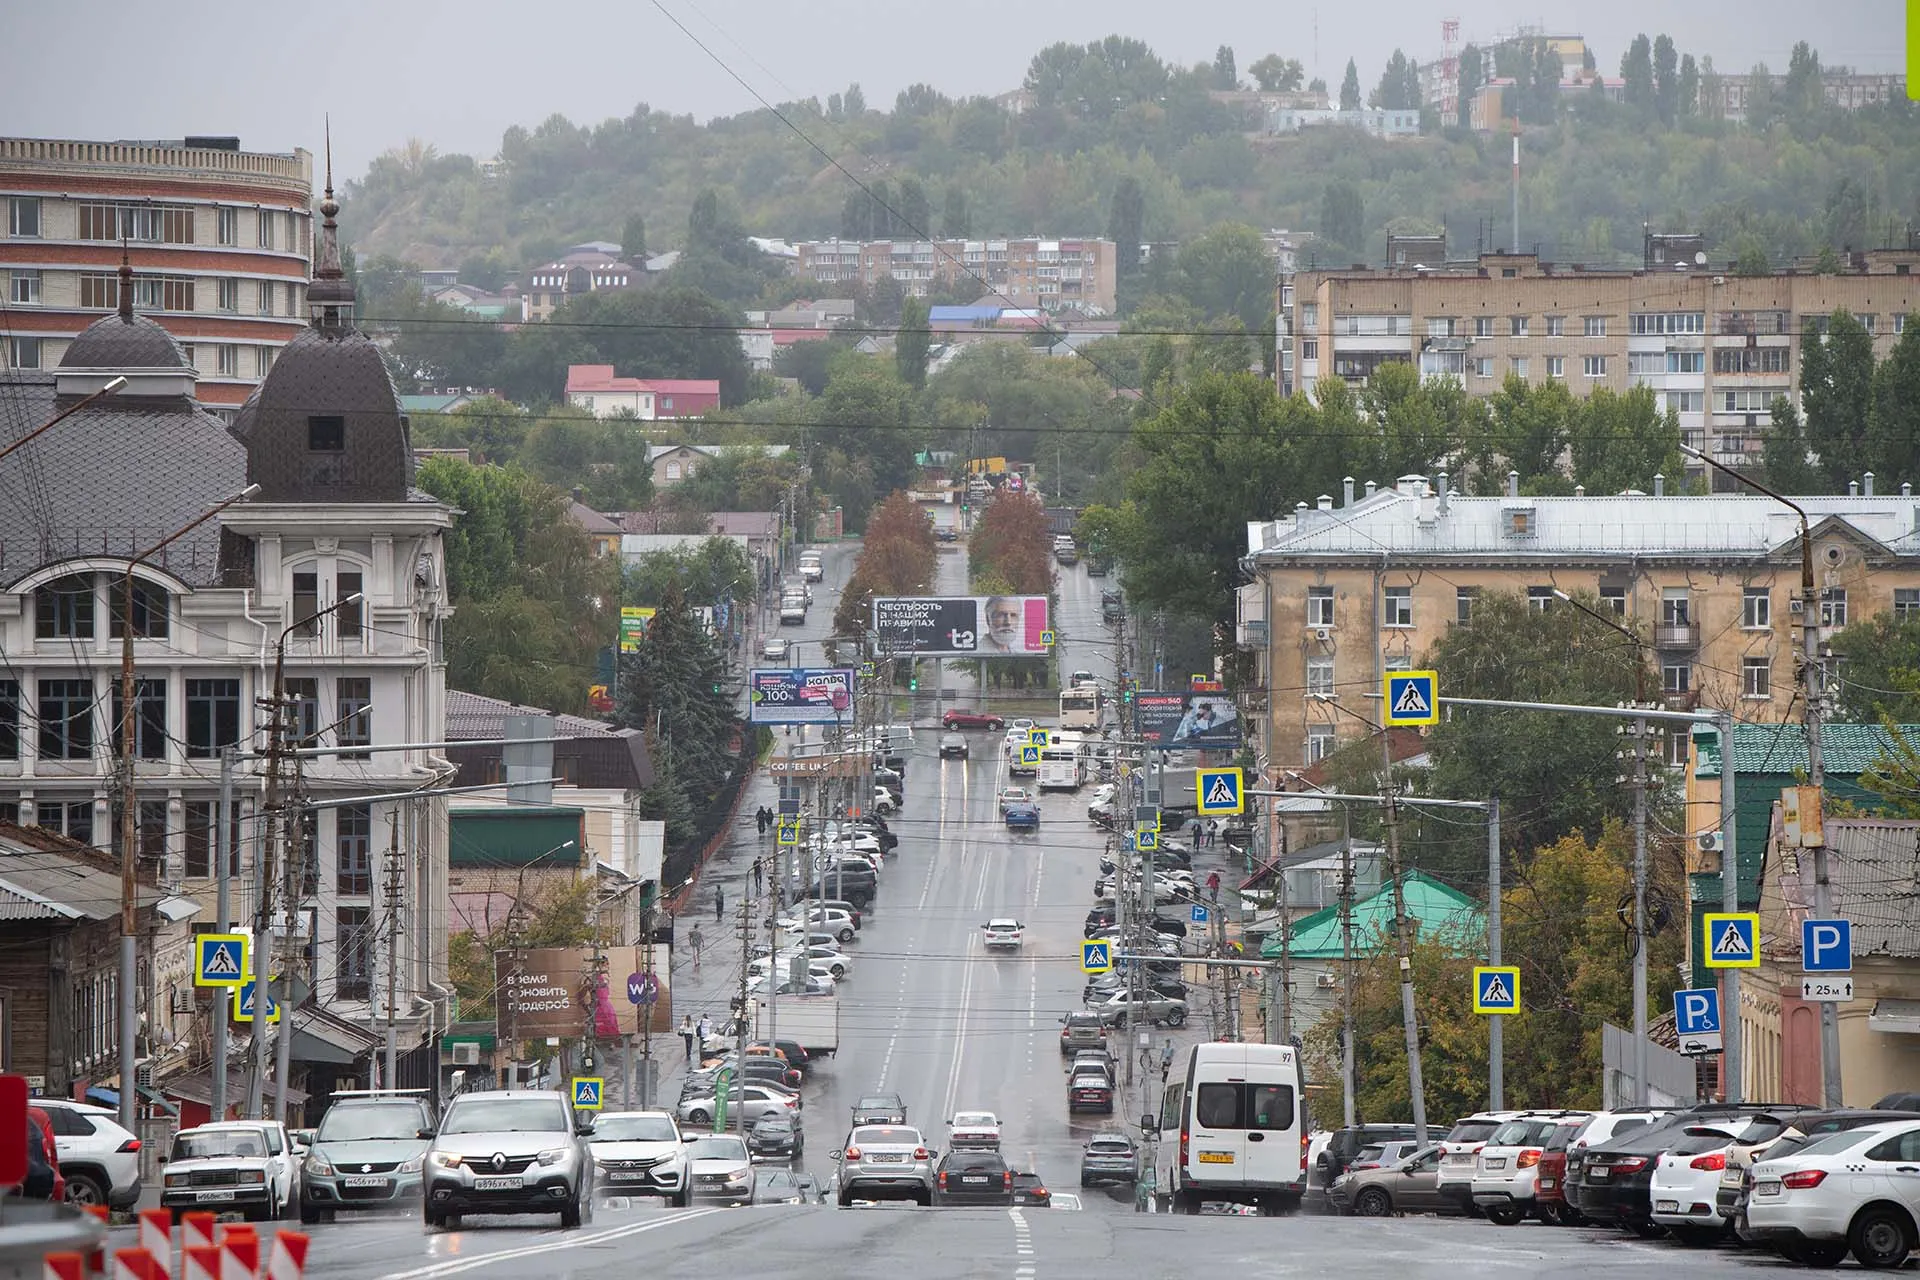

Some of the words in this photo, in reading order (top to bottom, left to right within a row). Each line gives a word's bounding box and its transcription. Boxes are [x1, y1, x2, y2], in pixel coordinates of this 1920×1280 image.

[951, 629, 974, 649] t2
[1195, 908, 1205, 919] P
[1813, 926, 1840, 964] P
[1816, 985, 1830, 996] 25
[1685, 995, 1708, 1028] P
[1282, 1053, 1291, 1063] 97
